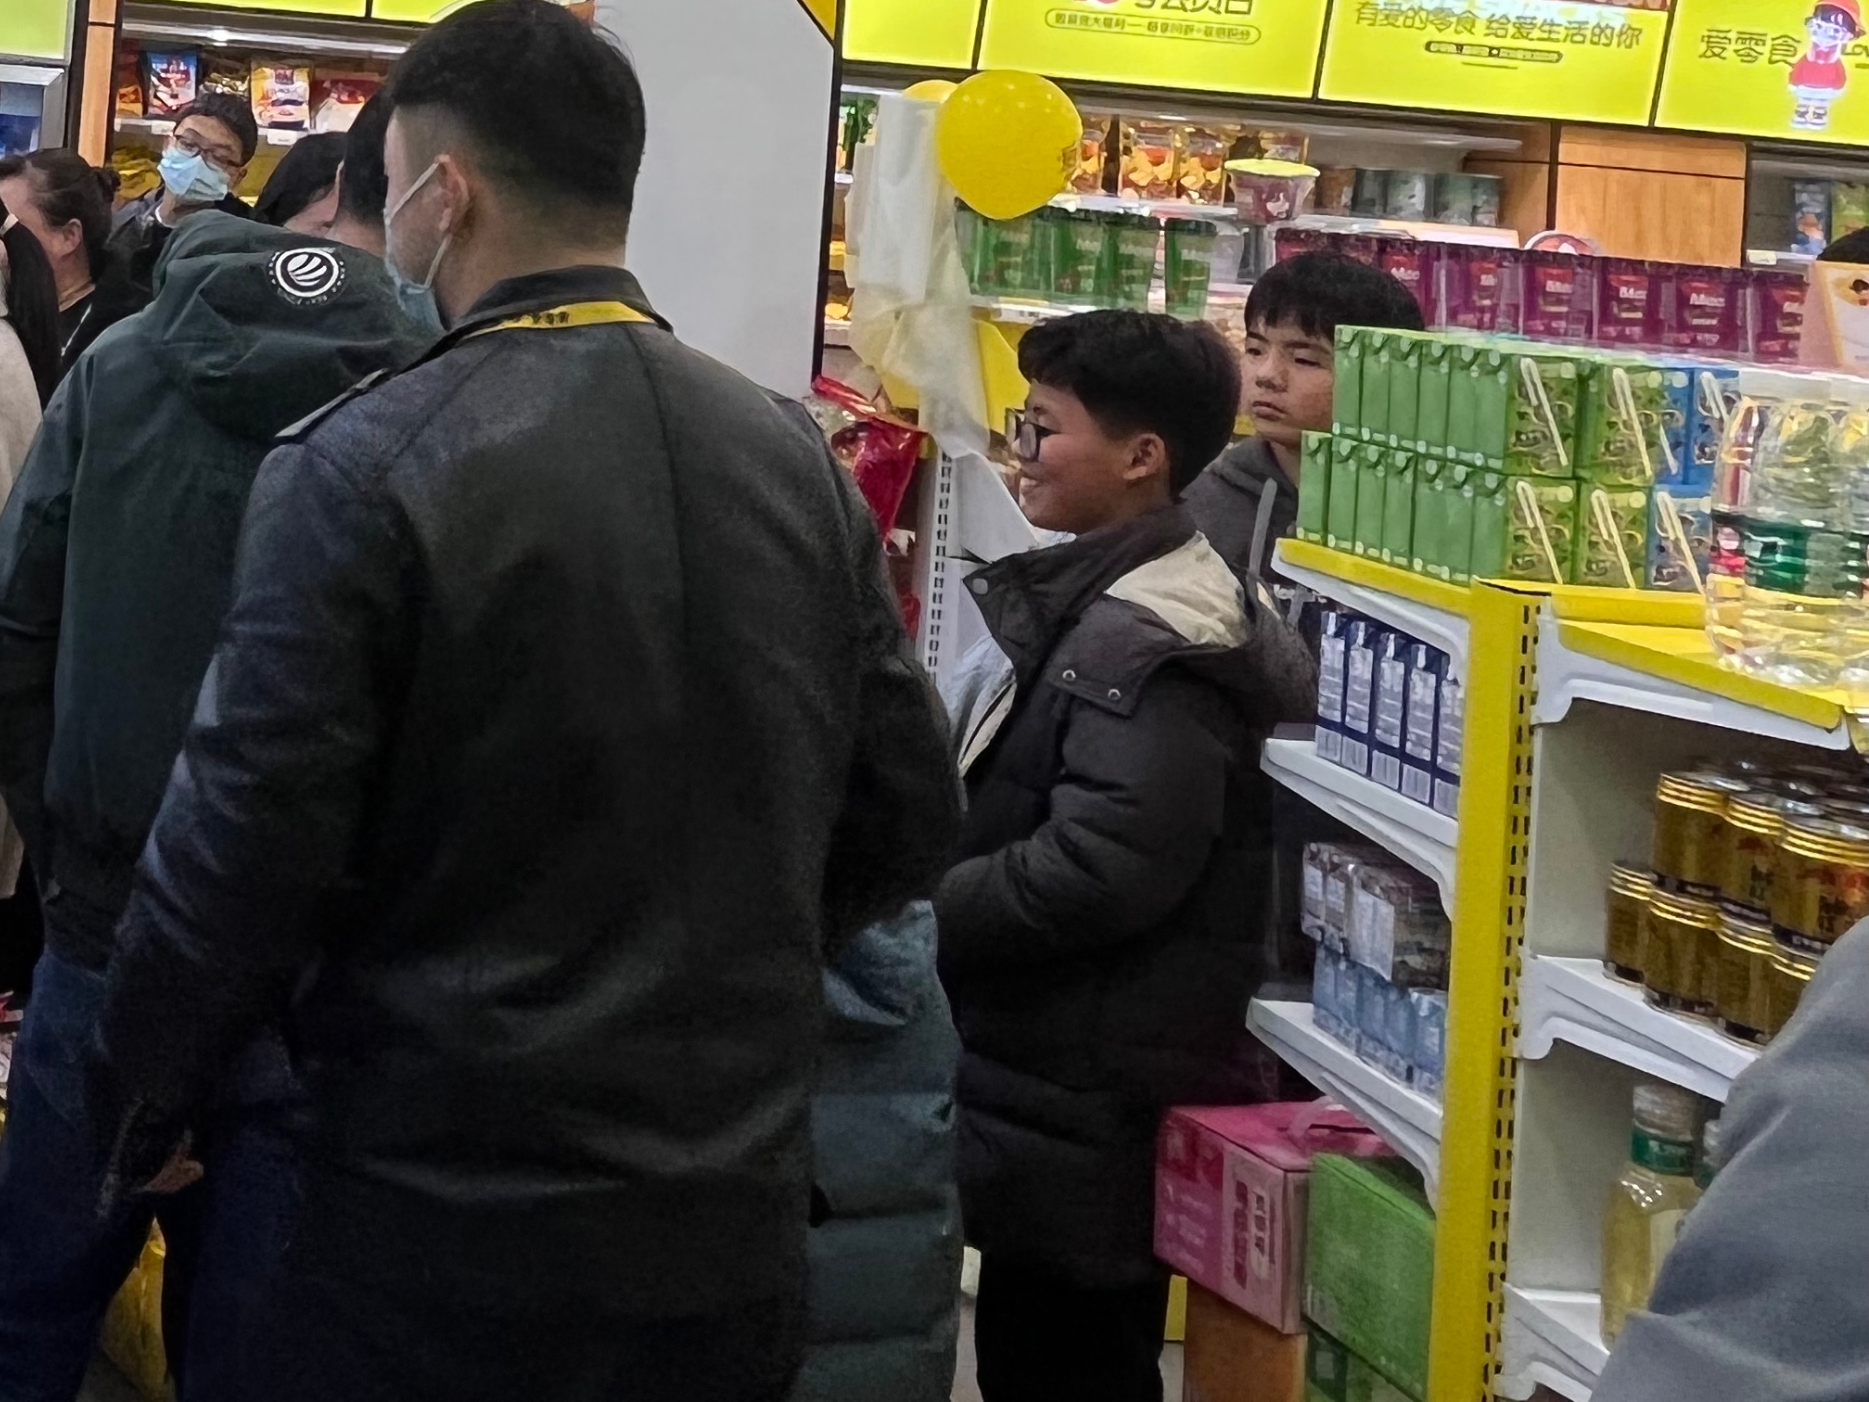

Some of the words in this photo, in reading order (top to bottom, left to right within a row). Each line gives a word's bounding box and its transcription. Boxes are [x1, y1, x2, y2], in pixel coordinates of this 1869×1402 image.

[1484, 13, 1643, 49] 给爱生活的你
[1698, 28, 1802, 68] 爱零食
